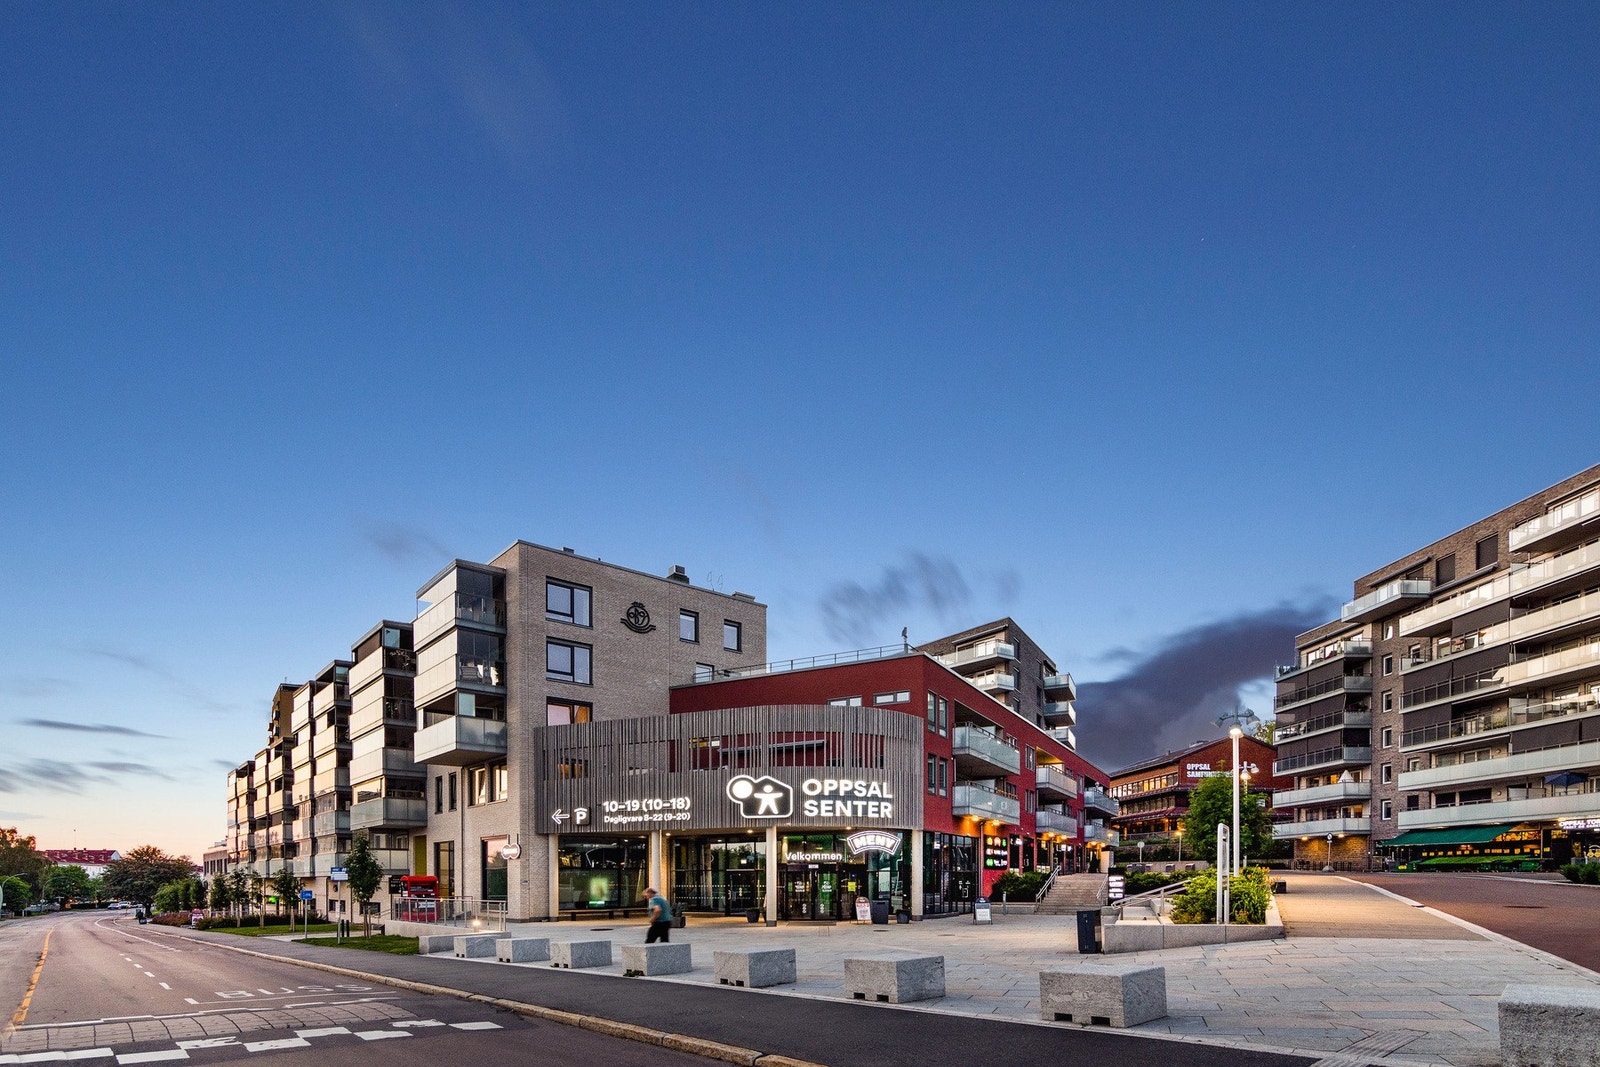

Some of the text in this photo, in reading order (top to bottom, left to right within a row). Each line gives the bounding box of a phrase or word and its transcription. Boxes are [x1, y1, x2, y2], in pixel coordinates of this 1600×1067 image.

[802, 778, 893, 799] OPPSAL
[803, 800, 892, 819] SENTER
[576, 811, 587, 824] P
[604, 815, 643, 824] Dagligvare
[853, 835, 896, 848] MENY
[785, 852, 843, 861] Velkommen
